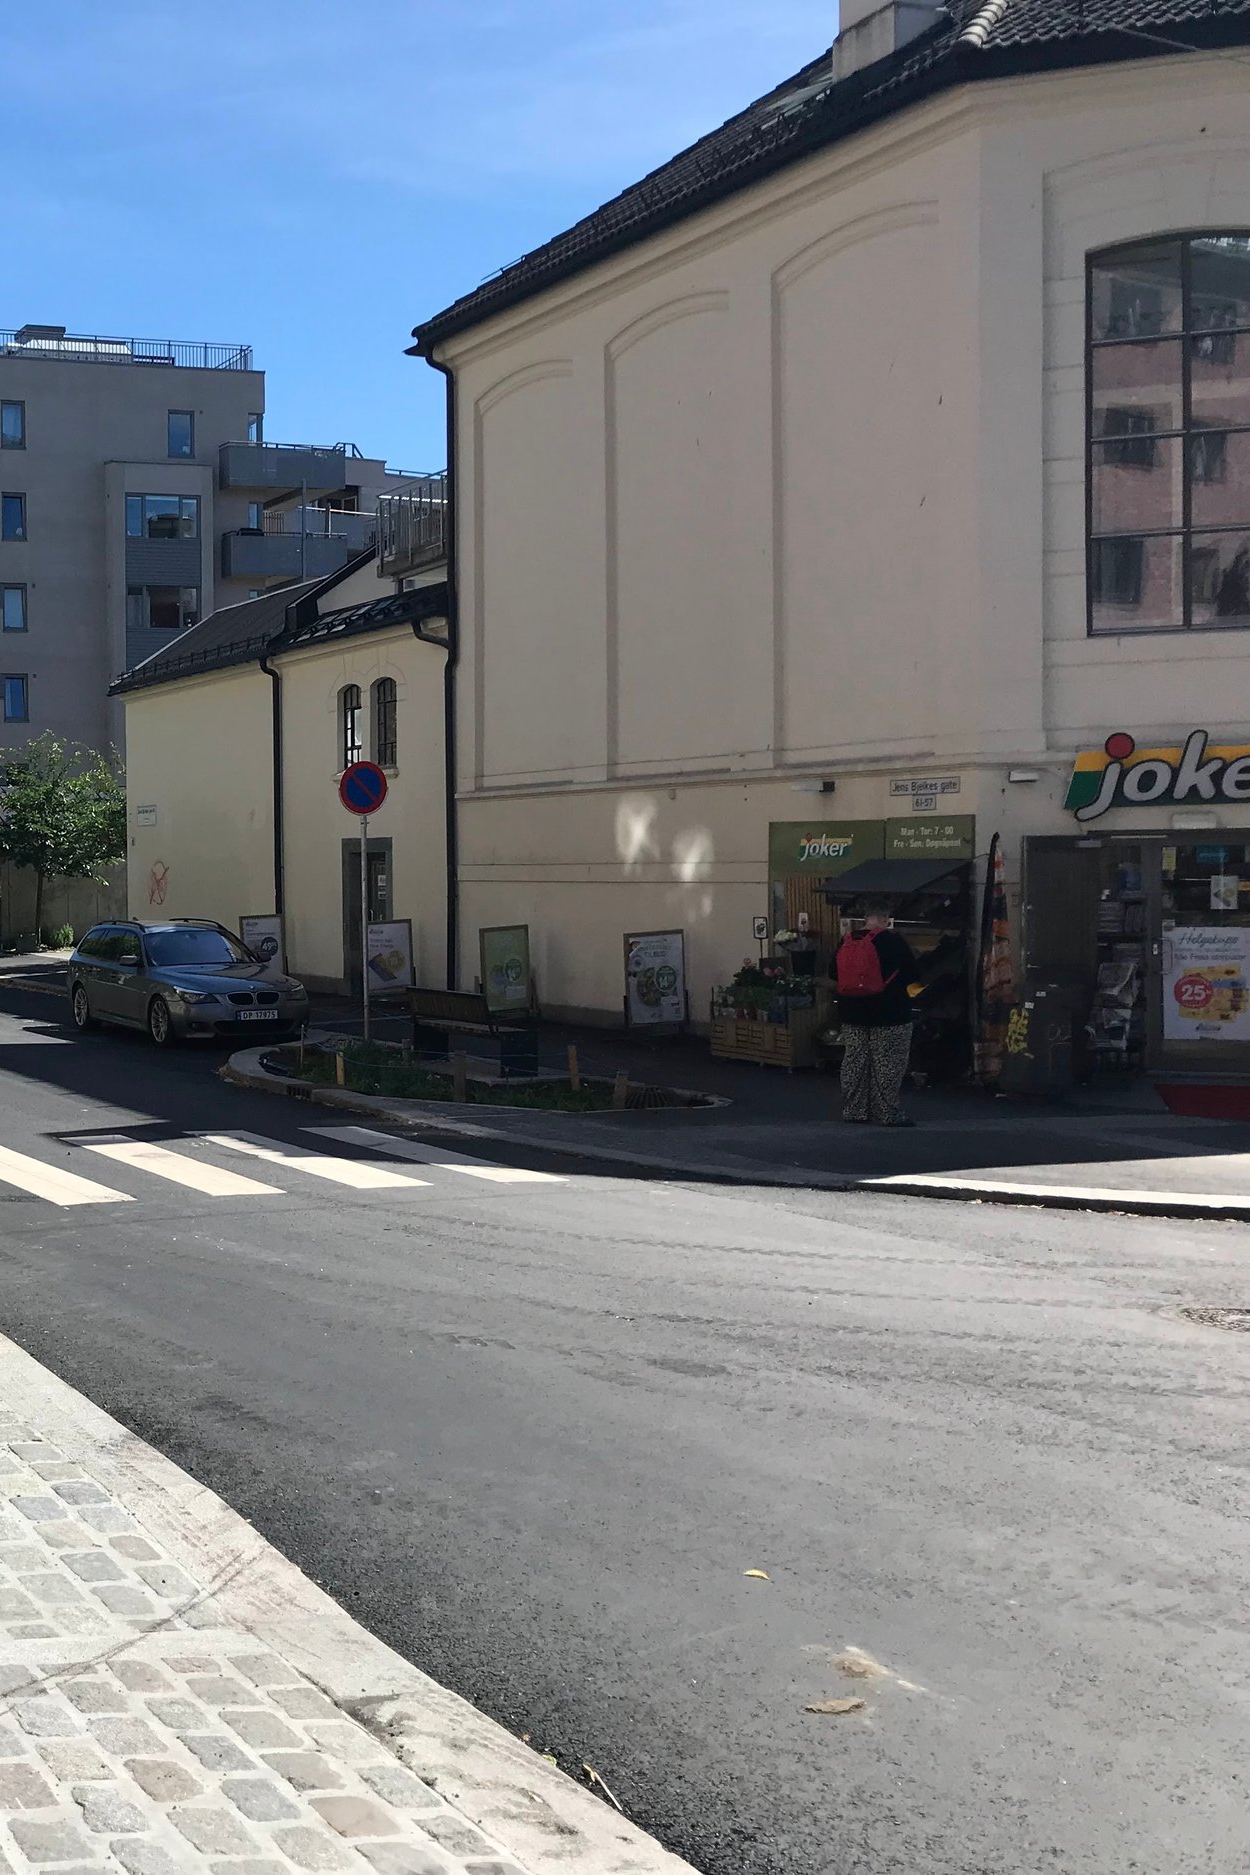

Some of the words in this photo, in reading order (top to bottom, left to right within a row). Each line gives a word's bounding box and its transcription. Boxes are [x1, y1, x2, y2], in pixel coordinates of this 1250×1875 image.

[892, 783, 909, 792] Jens
[940, 781, 958, 793] gate
[799, 832, 849, 861] joker
[1181, 984, 1206, 1001] 25
